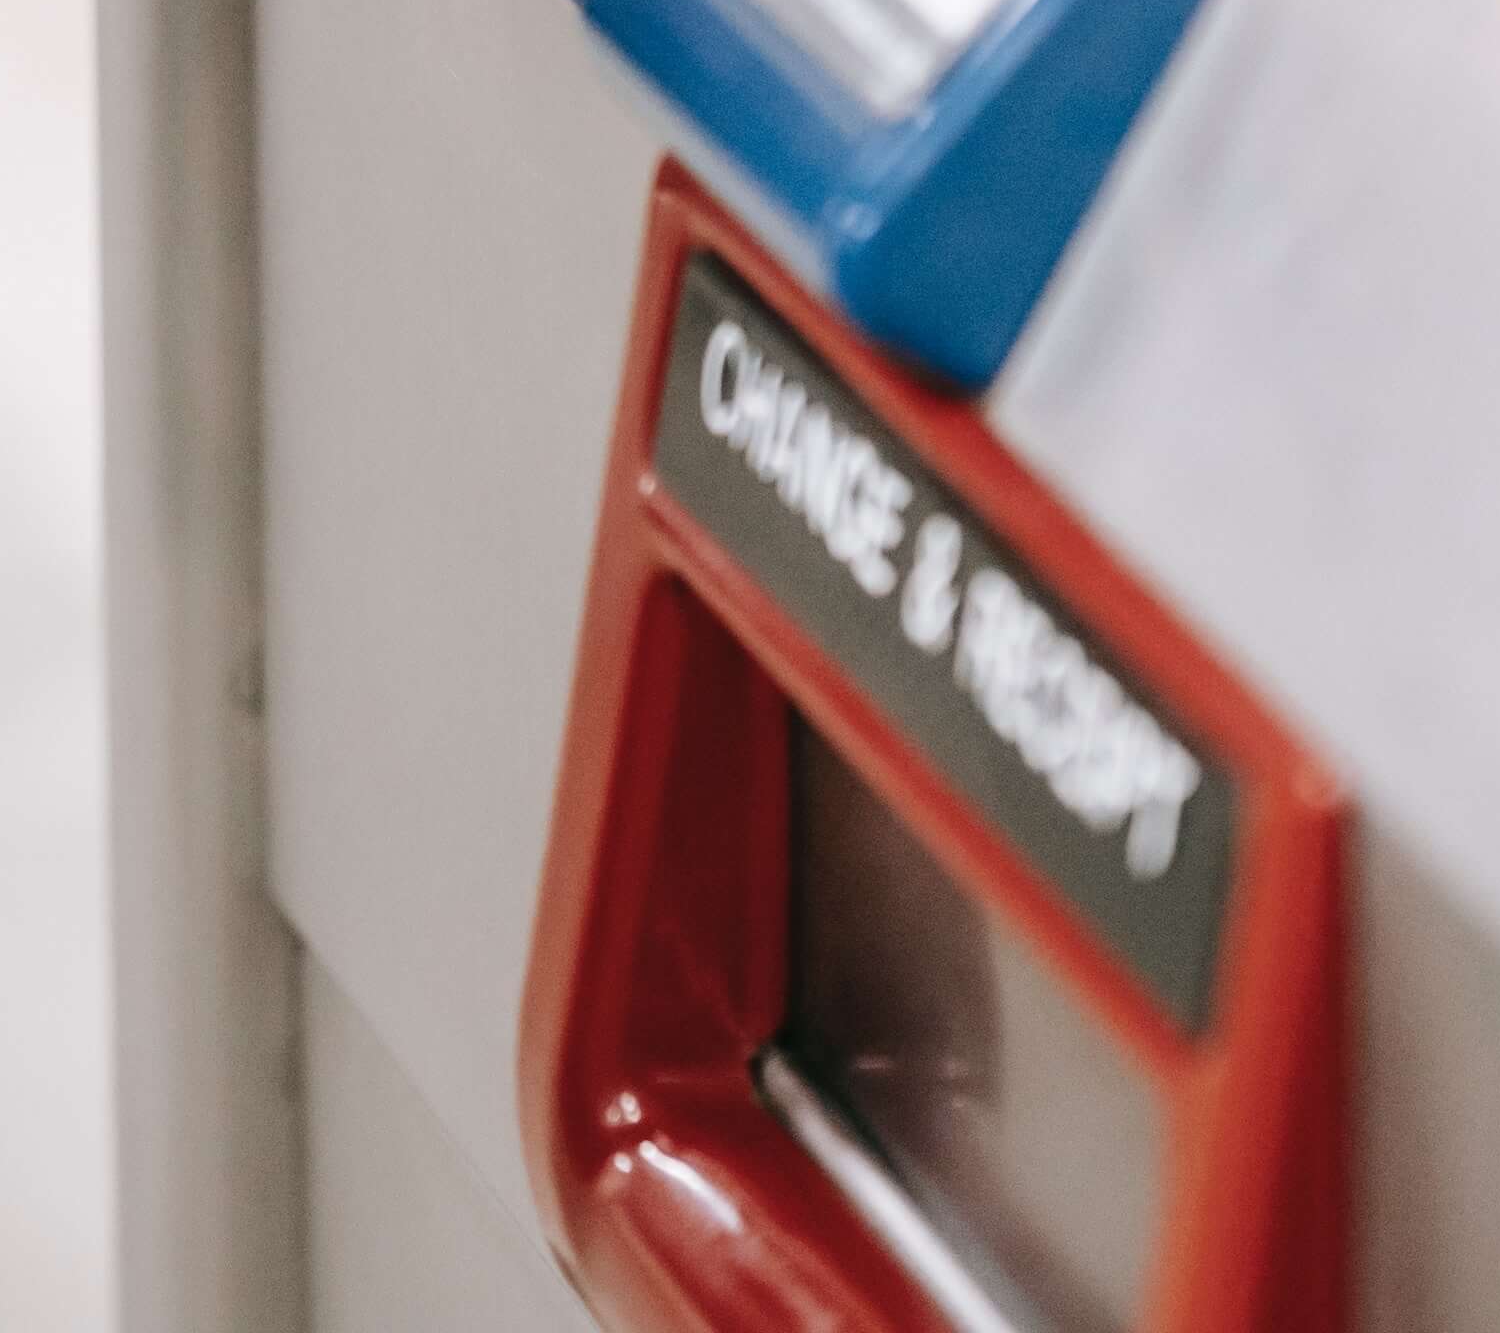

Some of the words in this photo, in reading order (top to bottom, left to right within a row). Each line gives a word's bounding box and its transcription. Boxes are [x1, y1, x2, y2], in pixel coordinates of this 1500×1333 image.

[701, 321, 913, 597] CHANGE
[900, 514, 963, 652] &
[953, 568, 1201, 881] RECEIPT
